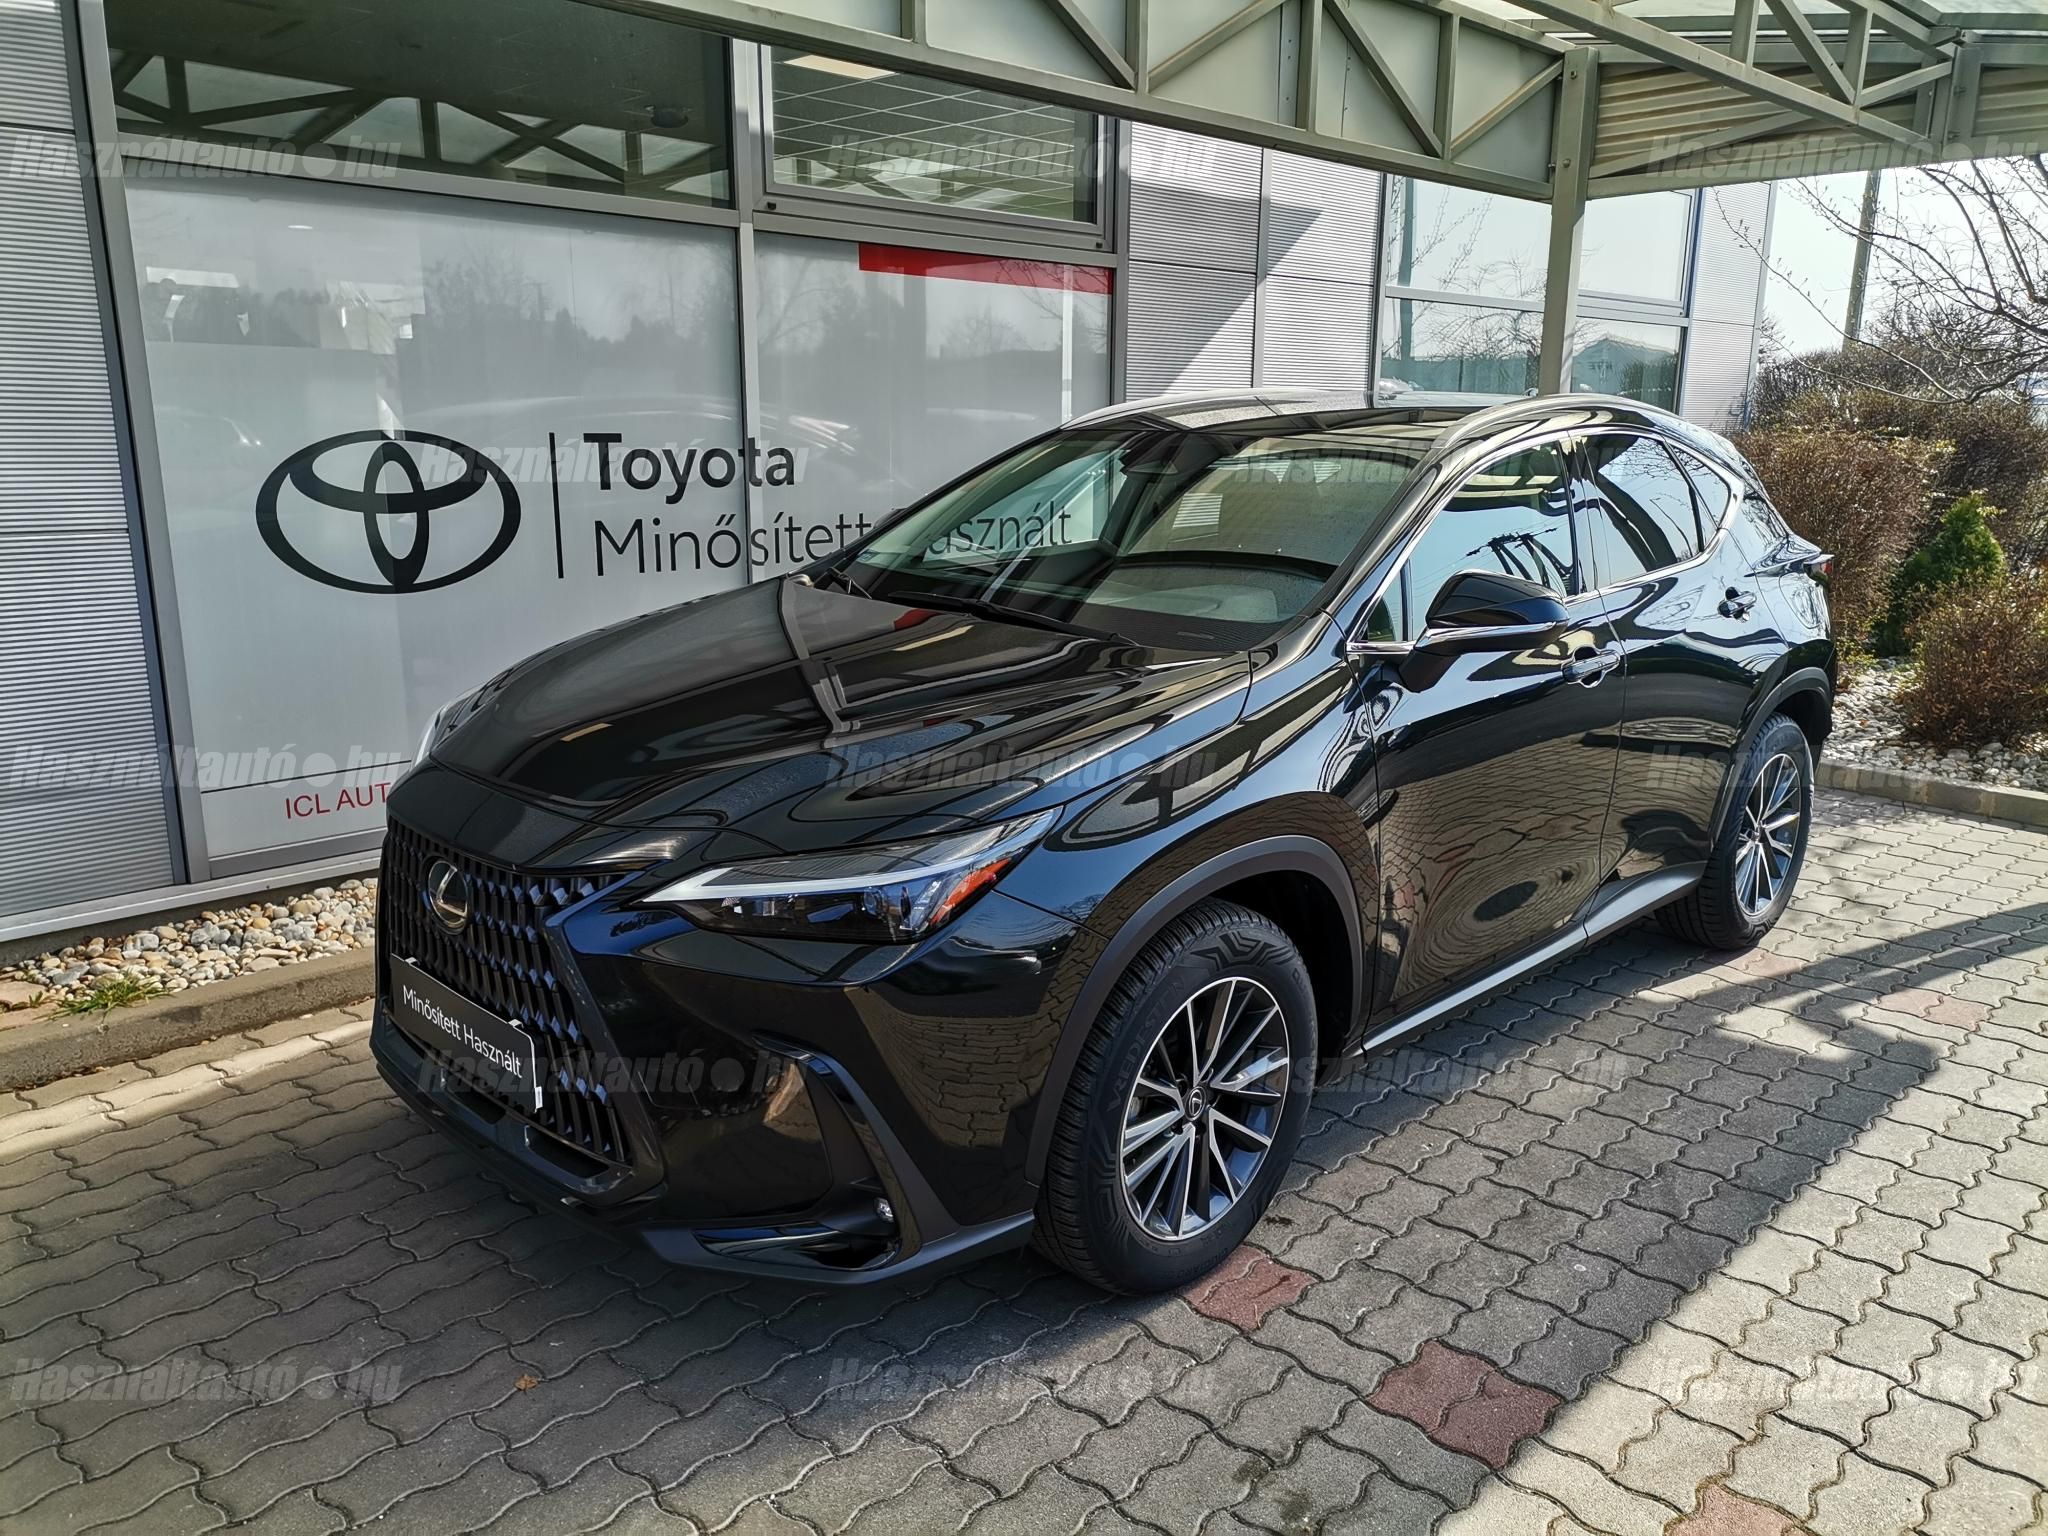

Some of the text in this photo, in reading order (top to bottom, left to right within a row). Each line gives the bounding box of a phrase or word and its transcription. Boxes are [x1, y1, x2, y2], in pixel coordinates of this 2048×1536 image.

[583, 433, 795, 505] Toyota
[928, 501, 1073, 556] asznált
[285, 782, 391, 819] ICL AUT
[402, 984, 523, 1079] Minősített Használt
